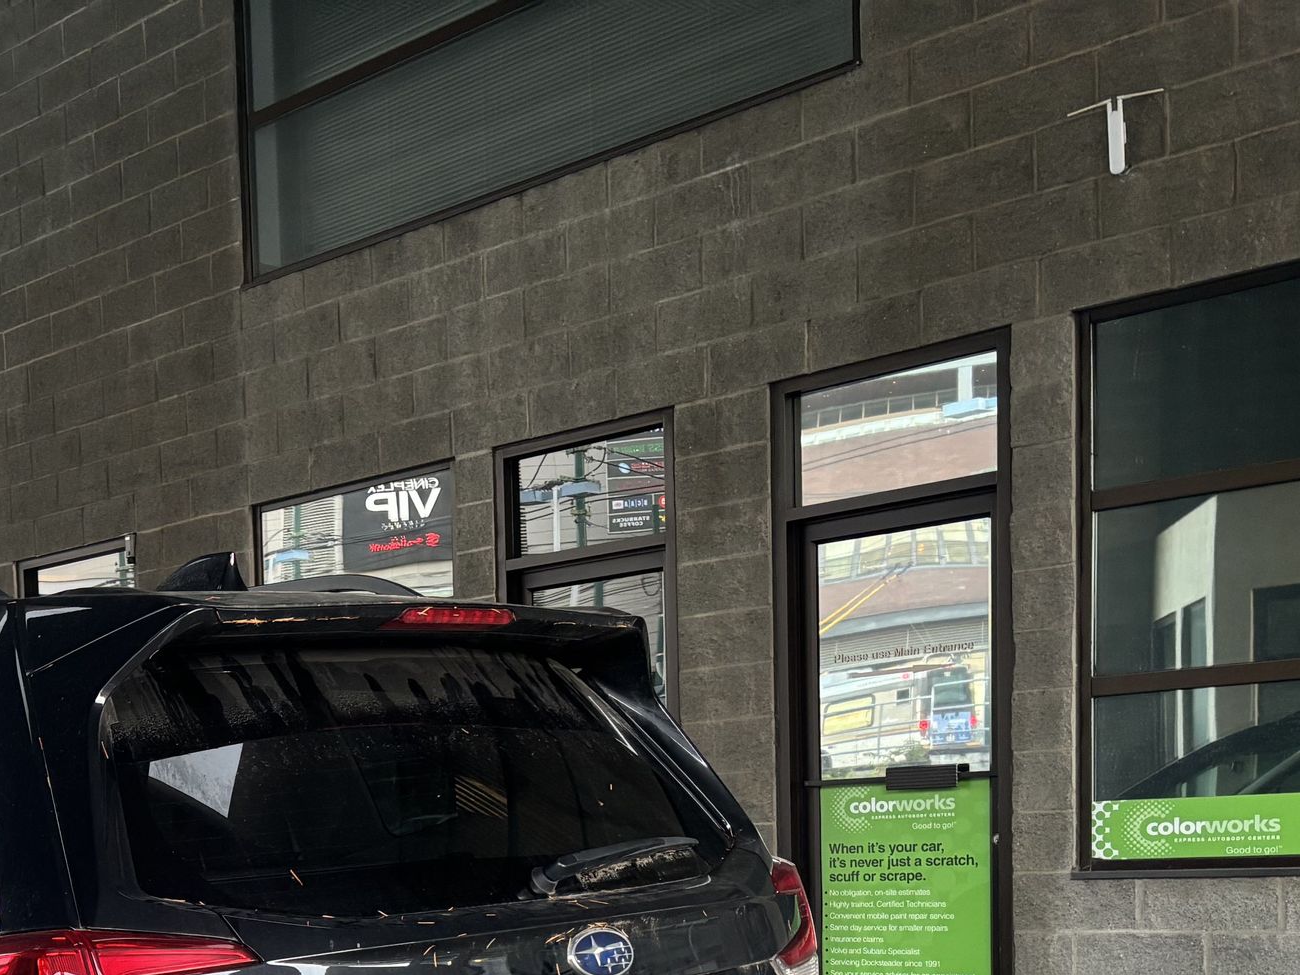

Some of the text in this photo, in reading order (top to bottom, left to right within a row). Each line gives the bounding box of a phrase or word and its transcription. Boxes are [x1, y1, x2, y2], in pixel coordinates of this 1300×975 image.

[834, 641, 975, 664] Please use Main Entrance
[849, 794, 956, 814] colorworks
[912, 822, 932, 830] Good
[1146, 814, 1281, 836] colorworks
[829, 842, 945, 856] When it's your car,
[1225, 846, 1251, 855] Good
[1253, 846, 1262, 854] to
[829, 855, 979, 870] it's never just a scratch,
[829, 871, 926, 884] scuff or scrape.
[829, 901, 850, 909] Highly
[876, 900, 905, 908] Certified
[906, 900, 947, 908] Technicians
[829, 912, 866, 920] Convenient
[866, 912, 890, 920] mobile
[890, 913, 907, 921] paint
[908, 913, 928, 921] repair
[850, 924, 862, 932] day
[862, 924, 887, 932] service
[888, 924, 898, 932] for
[899, 924, 923, 932] smaller
[924, 925, 948, 933] repairs
[887, 948, 920, 956] Specialist
[830, 959, 860, 967] Servicing
[861, 959, 903, 967] Docksteader
[925, 960, 941, 968] 1991
